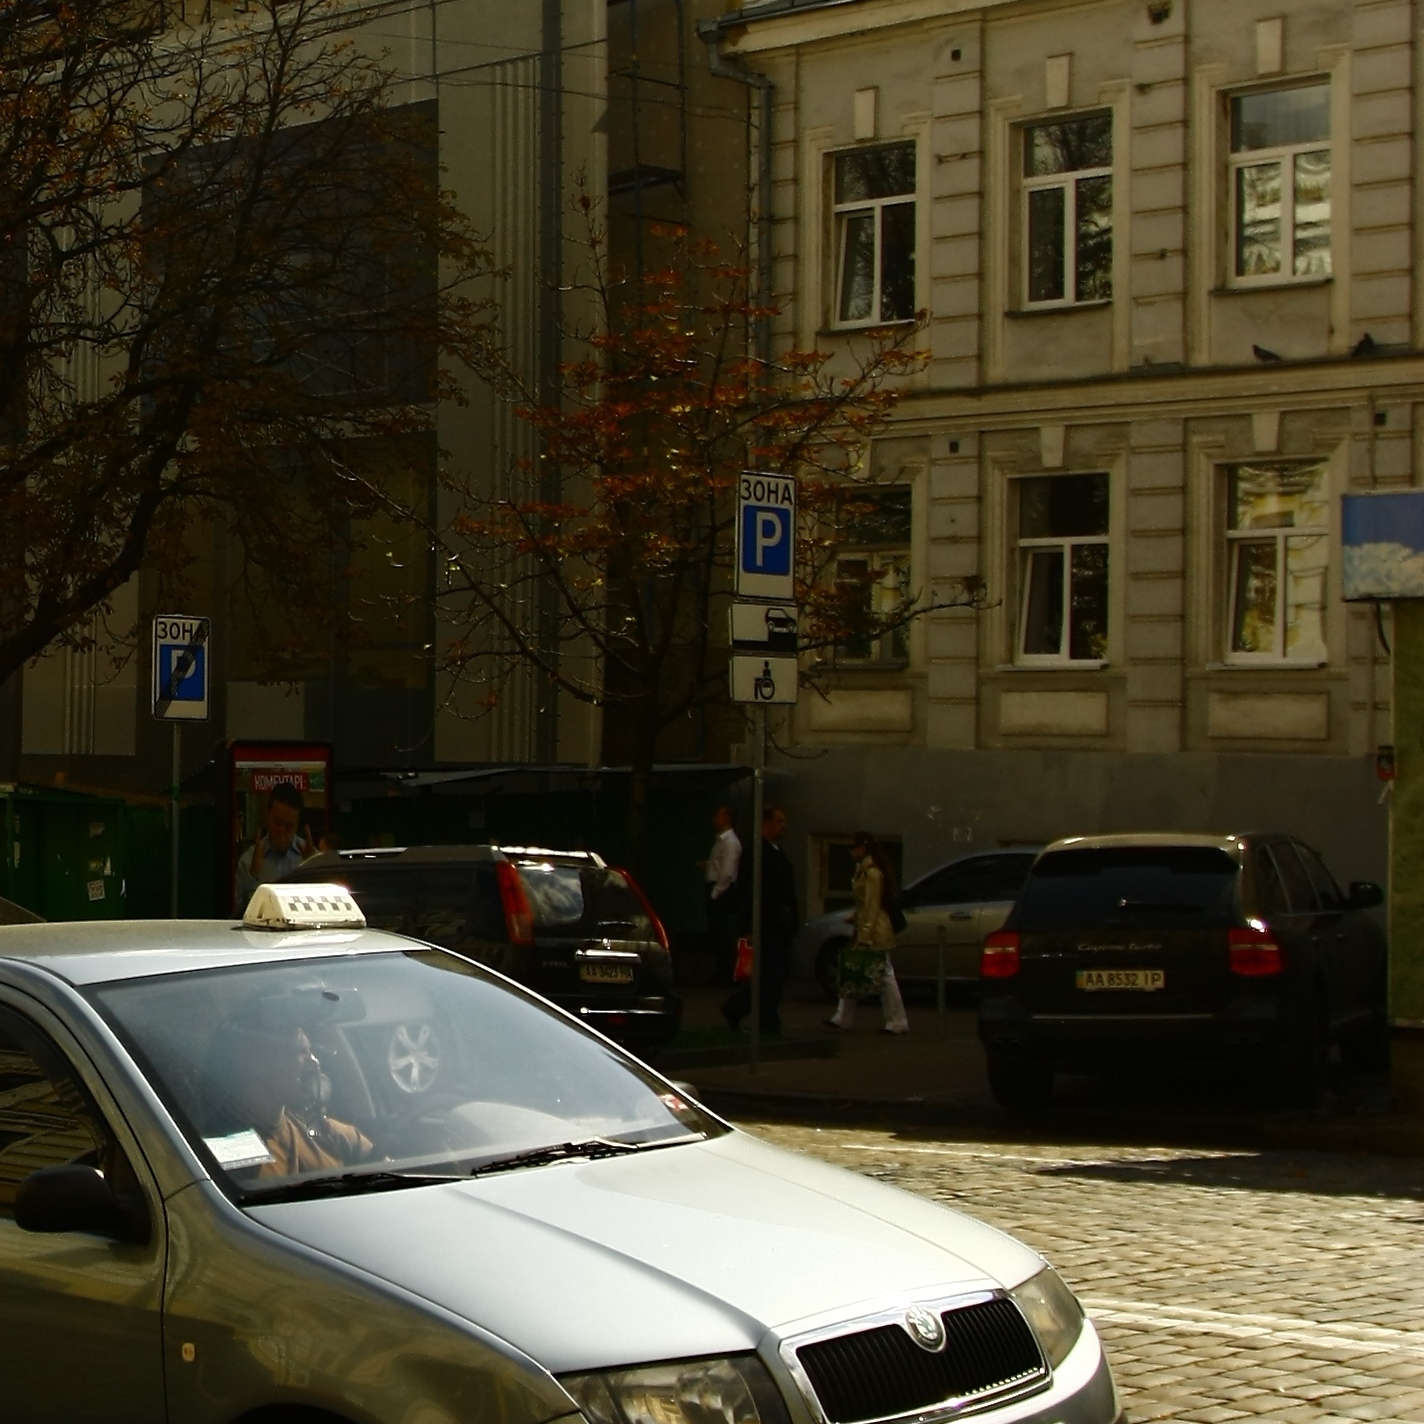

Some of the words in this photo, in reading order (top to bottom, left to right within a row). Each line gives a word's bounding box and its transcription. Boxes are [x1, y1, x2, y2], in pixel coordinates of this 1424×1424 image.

[741, 479, 793, 506] ЗОНА
[756, 510, 783, 568] P
[1086, 973, 1105, 986] AA
[1144, 973, 1162, 986] IP
